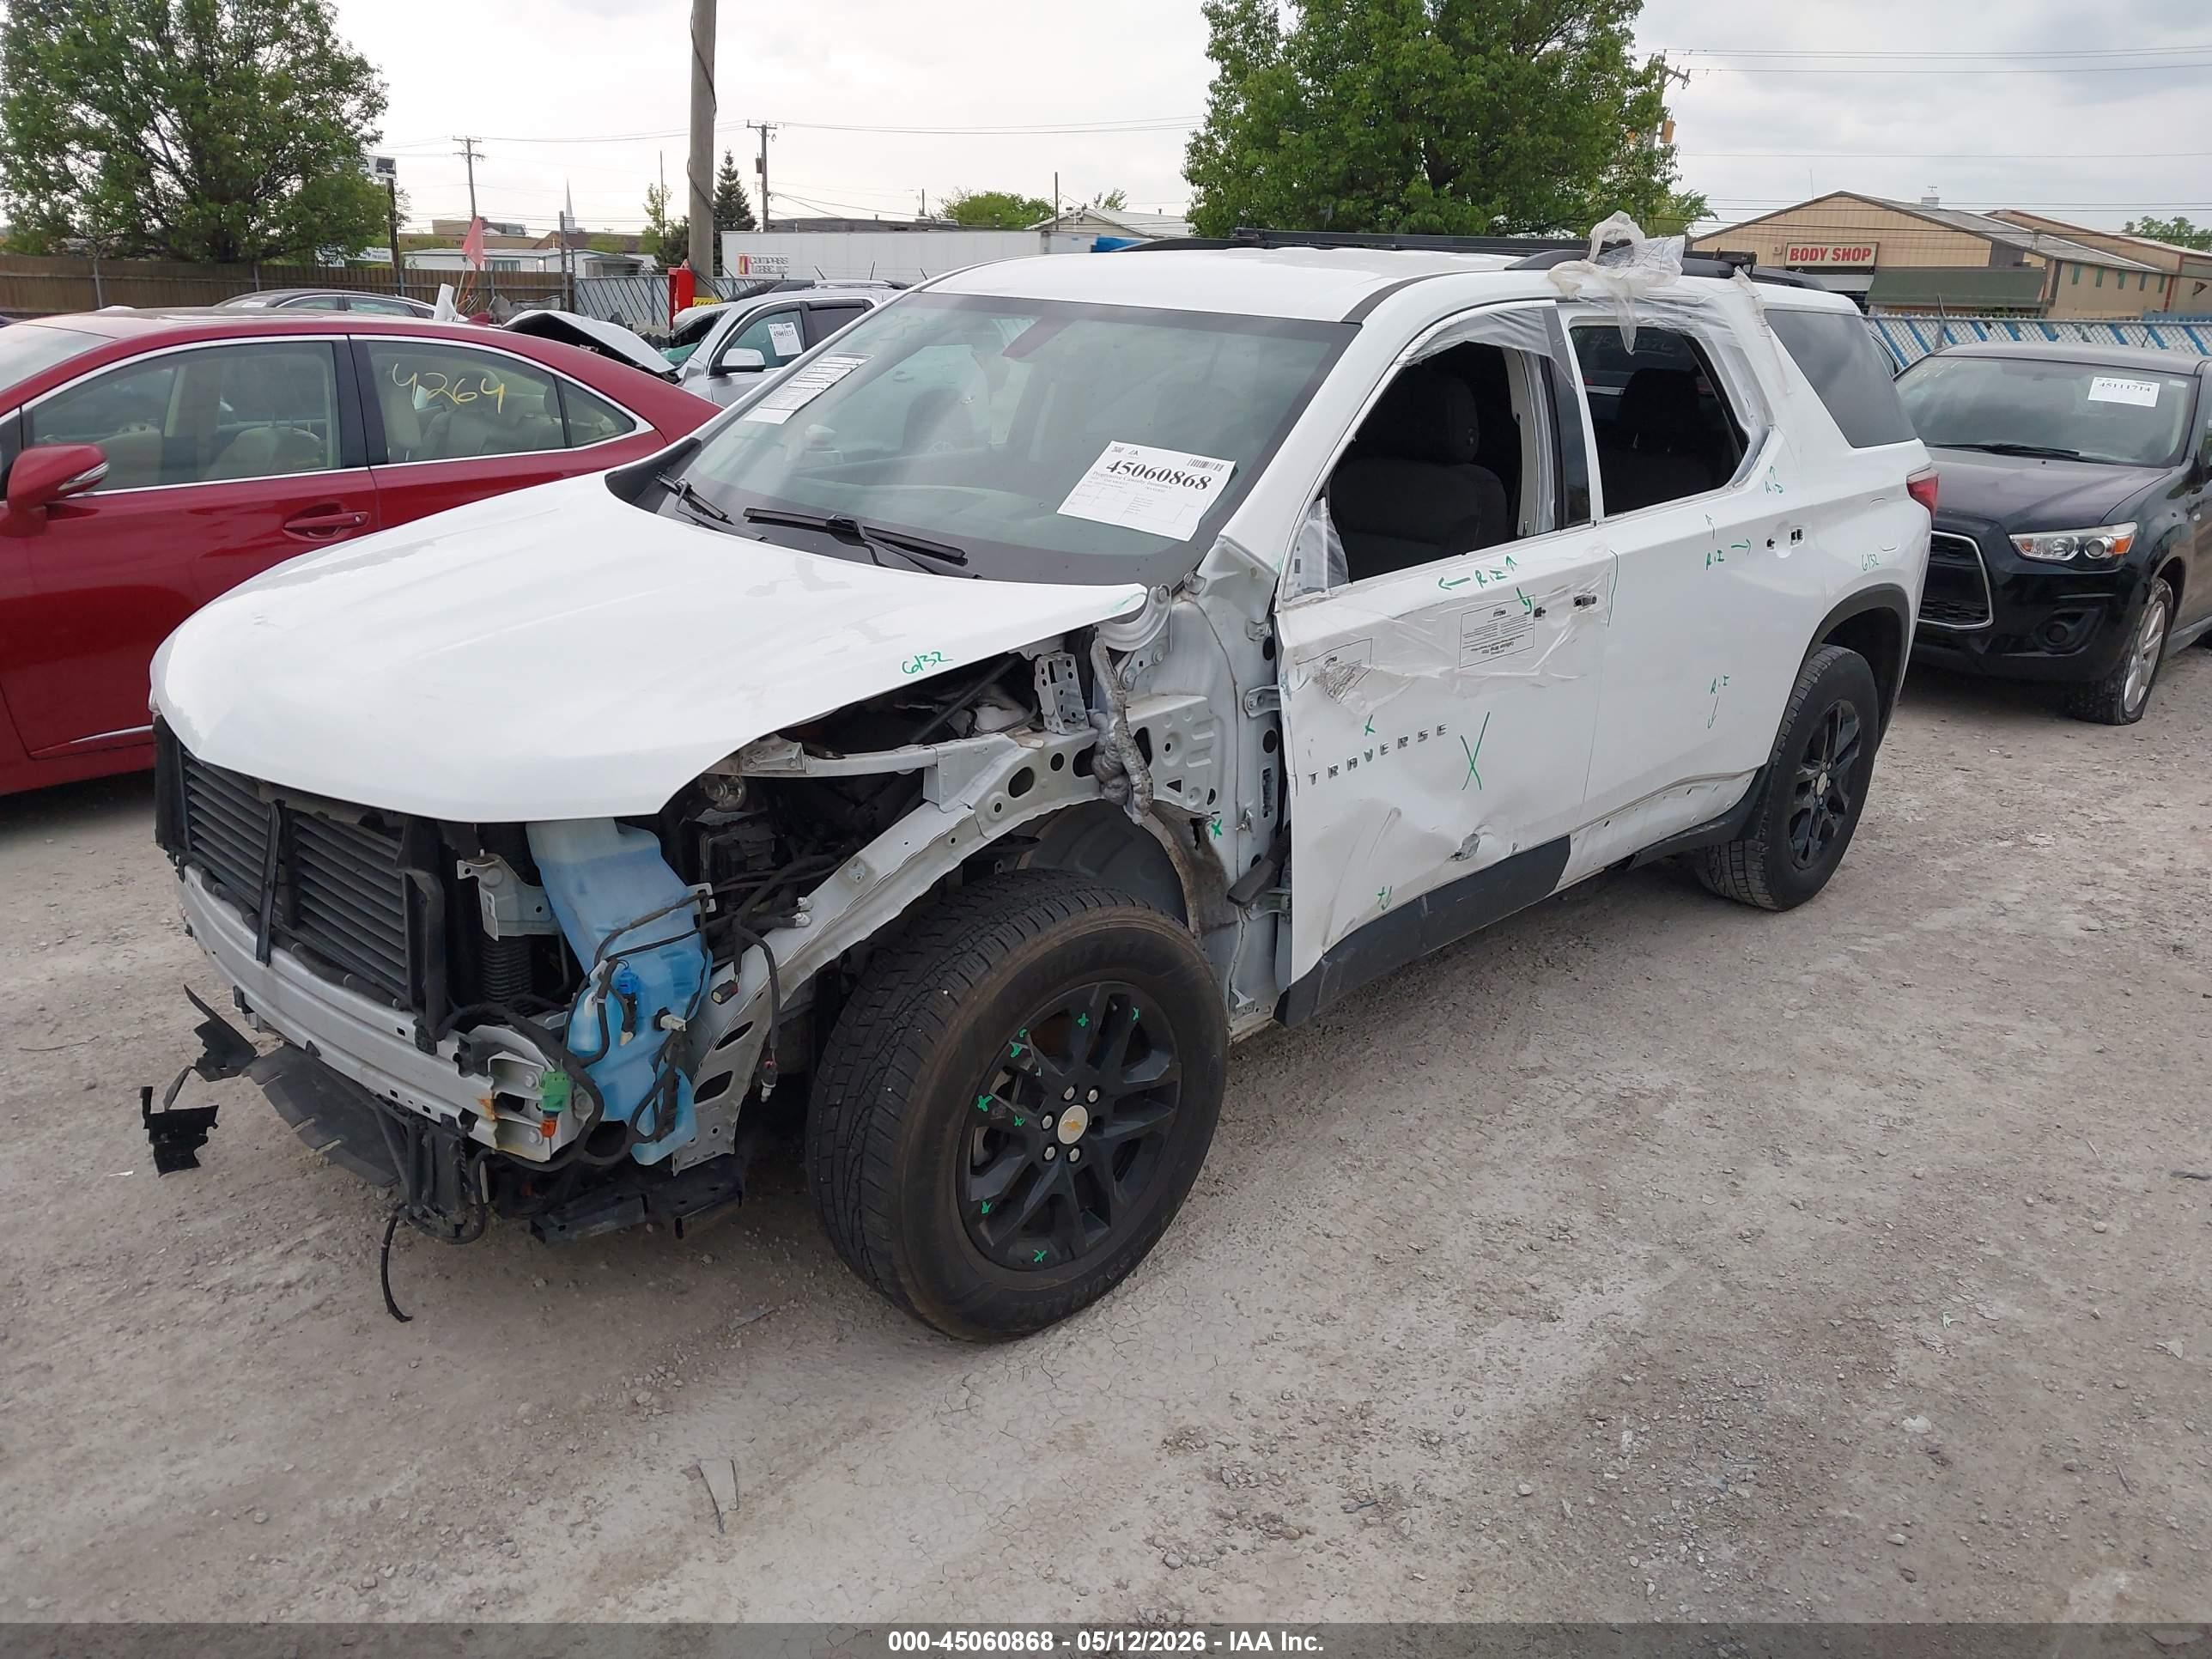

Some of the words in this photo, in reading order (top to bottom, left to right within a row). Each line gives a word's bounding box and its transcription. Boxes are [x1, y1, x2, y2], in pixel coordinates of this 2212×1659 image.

[1790, 247, 1829, 261] BODY
[1832, 247, 1872, 261] SHOP
[392, 362, 506, 415] 4264
[2099, 382, 2151, 392] 45111714
[1106, 459, 1212, 490] 45060868
[1308, 723, 1449, 786] TRAVERSE
